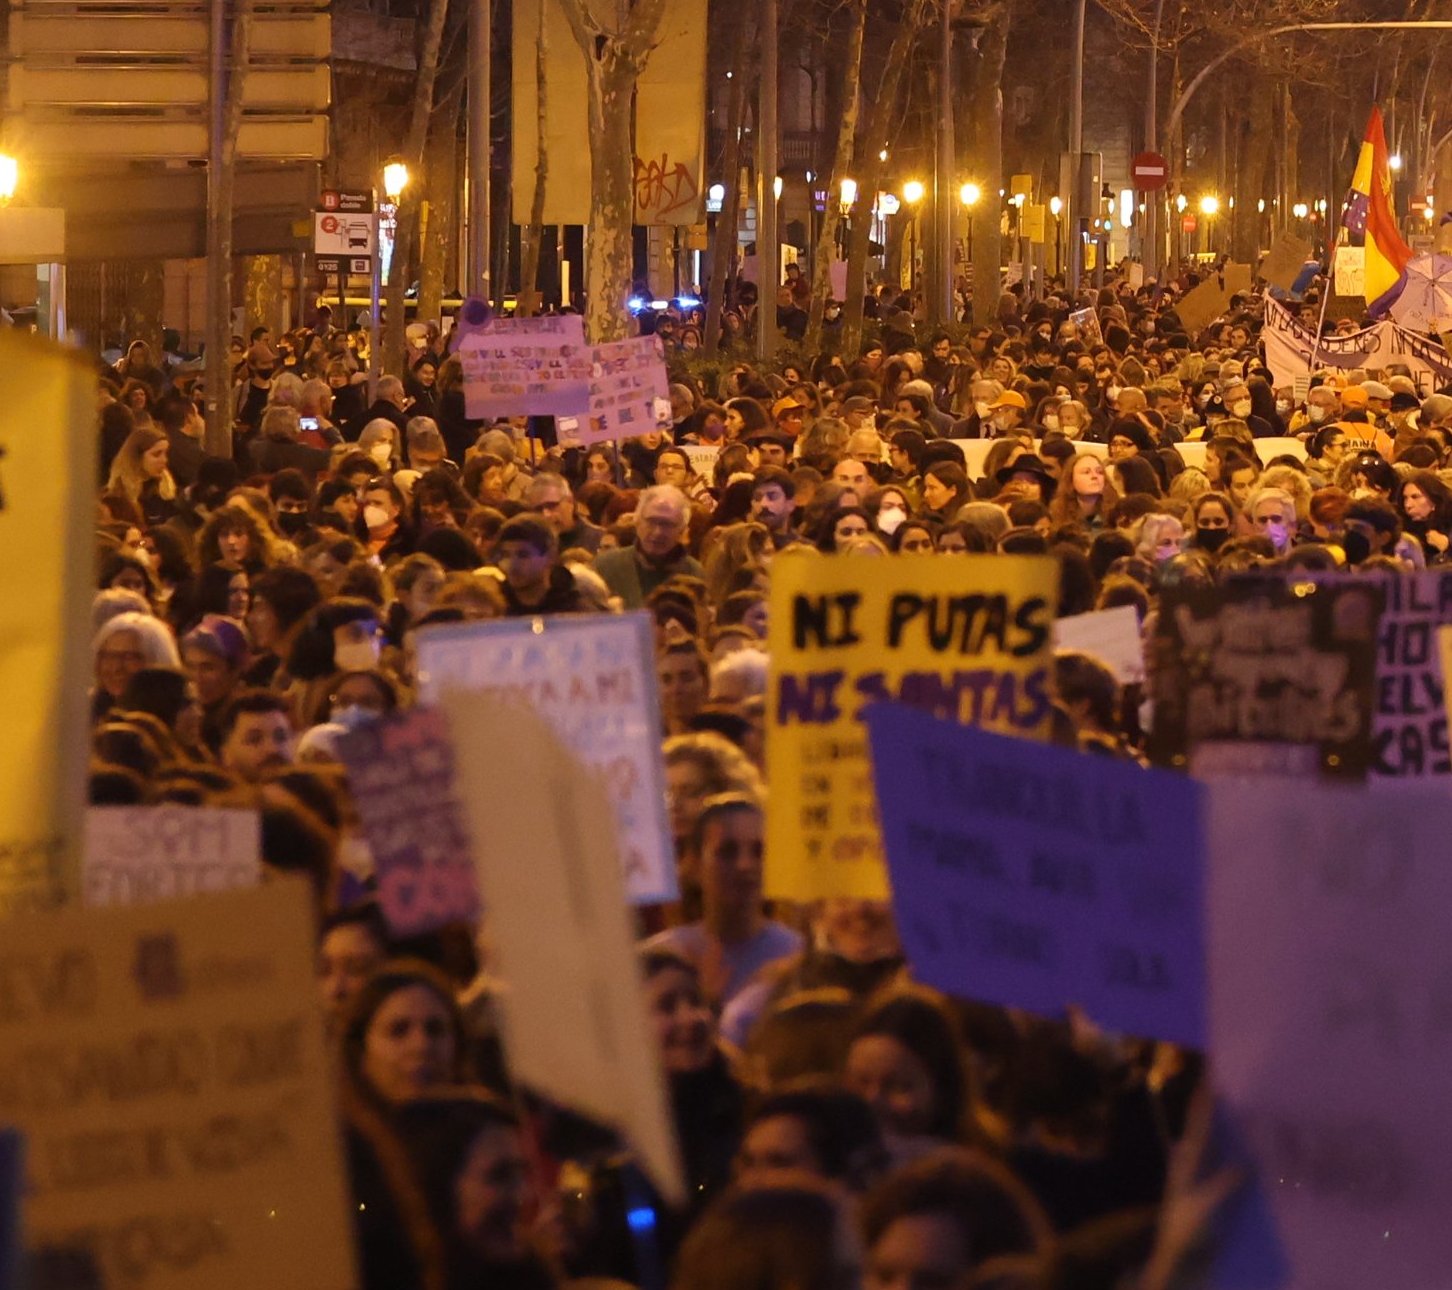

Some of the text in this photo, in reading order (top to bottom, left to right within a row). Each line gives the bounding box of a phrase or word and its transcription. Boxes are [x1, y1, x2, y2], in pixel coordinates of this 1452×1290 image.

[792, 593, 1048, 656] NI PUTAS
[777, 671, 844, 725] NI
